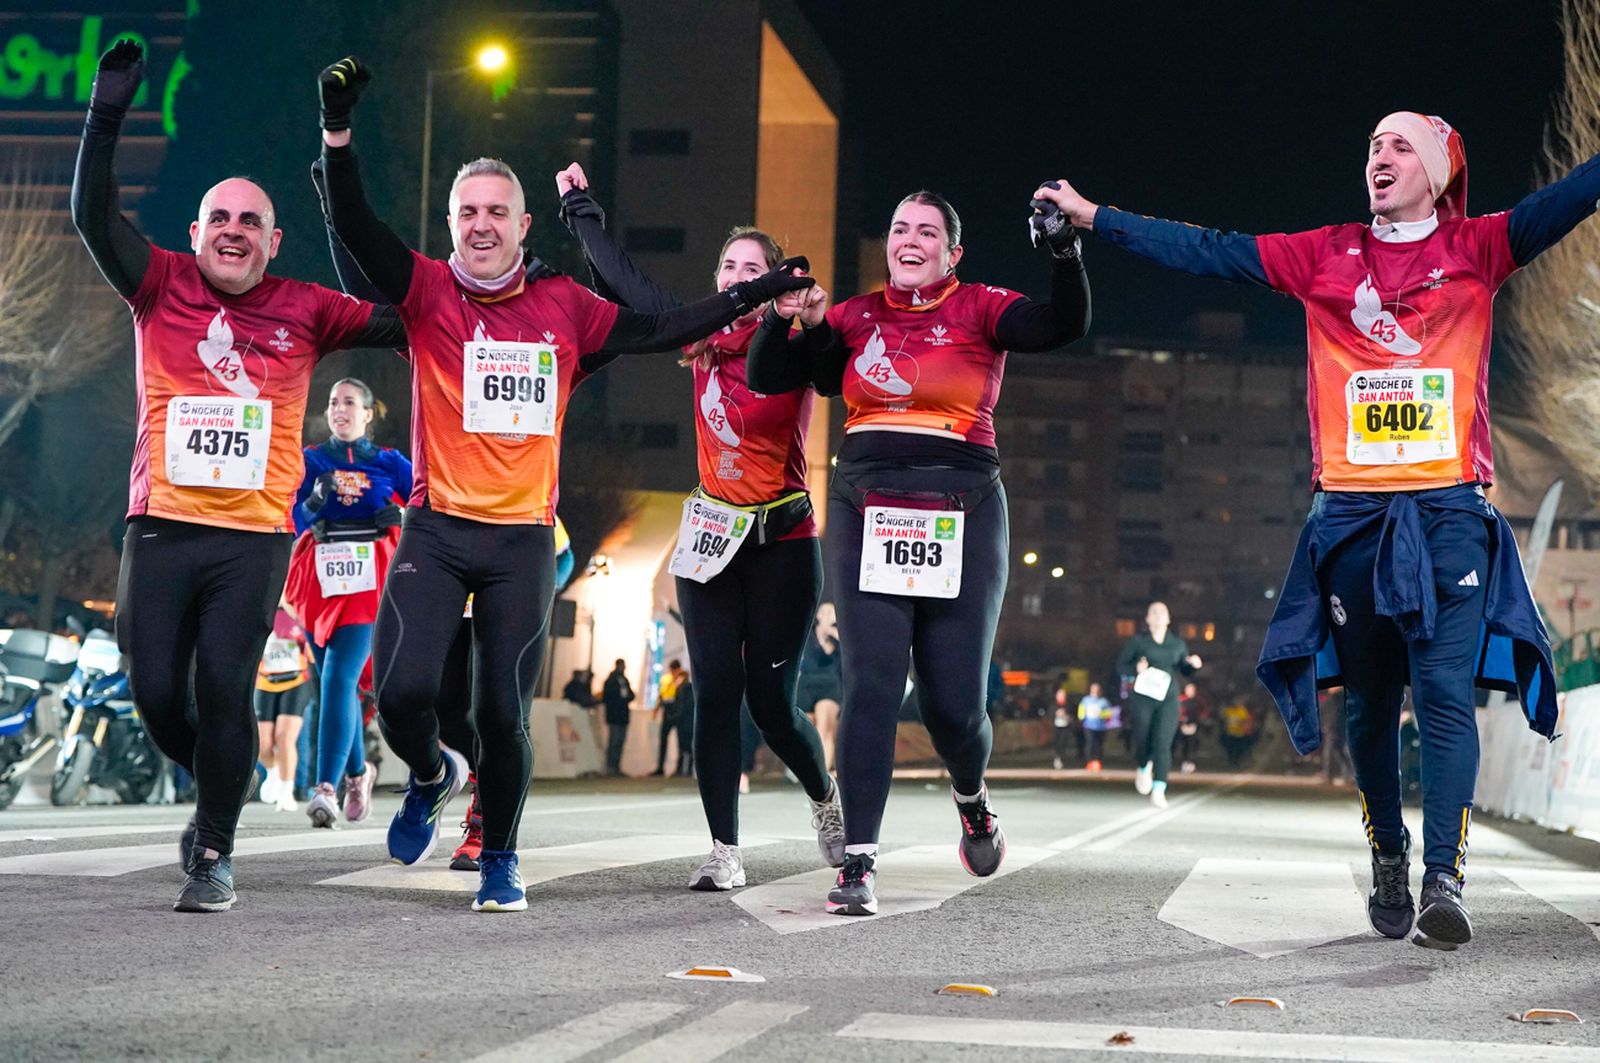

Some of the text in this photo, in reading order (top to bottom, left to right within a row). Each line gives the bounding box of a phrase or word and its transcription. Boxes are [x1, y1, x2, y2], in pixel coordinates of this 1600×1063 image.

[1370, 319, 1396, 343] 43
[488, 352, 530, 362] NOCHE DE
[213, 356, 240, 382] 43
[476, 363, 496, 372] SAN
[866, 363, 891, 383] 43
[483, 375, 546, 403] 6998
[1368, 380, 1413, 389] NOCHE DE
[1358, 392, 1377, 403] SAN
[1379, 389, 1414, 402] ANTÓN
[191, 407, 234, 416] NOCHE DE
[1366, 403, 1434, 432] 6402
[179, 417, 199, 426] SAN
[200, 416, 235, 428] ANTÓN
[708, 408, 725, 431] 43
[186, 429, 250, 458] 4375
[720, 514, 729, 525] DE
[886, 517, 914, 528] NOCHE
[915, 519, 927, 528] DE
[702, 520, 728, 535] ANTÓN
[875, 528, 893, 538] SAN
[895, 527, 927, 540] ANTÓN
[692, 530, 731, 558] 1694
[882, 540, 942, 567] 1693
[326, 561, 363, 577] 6307
